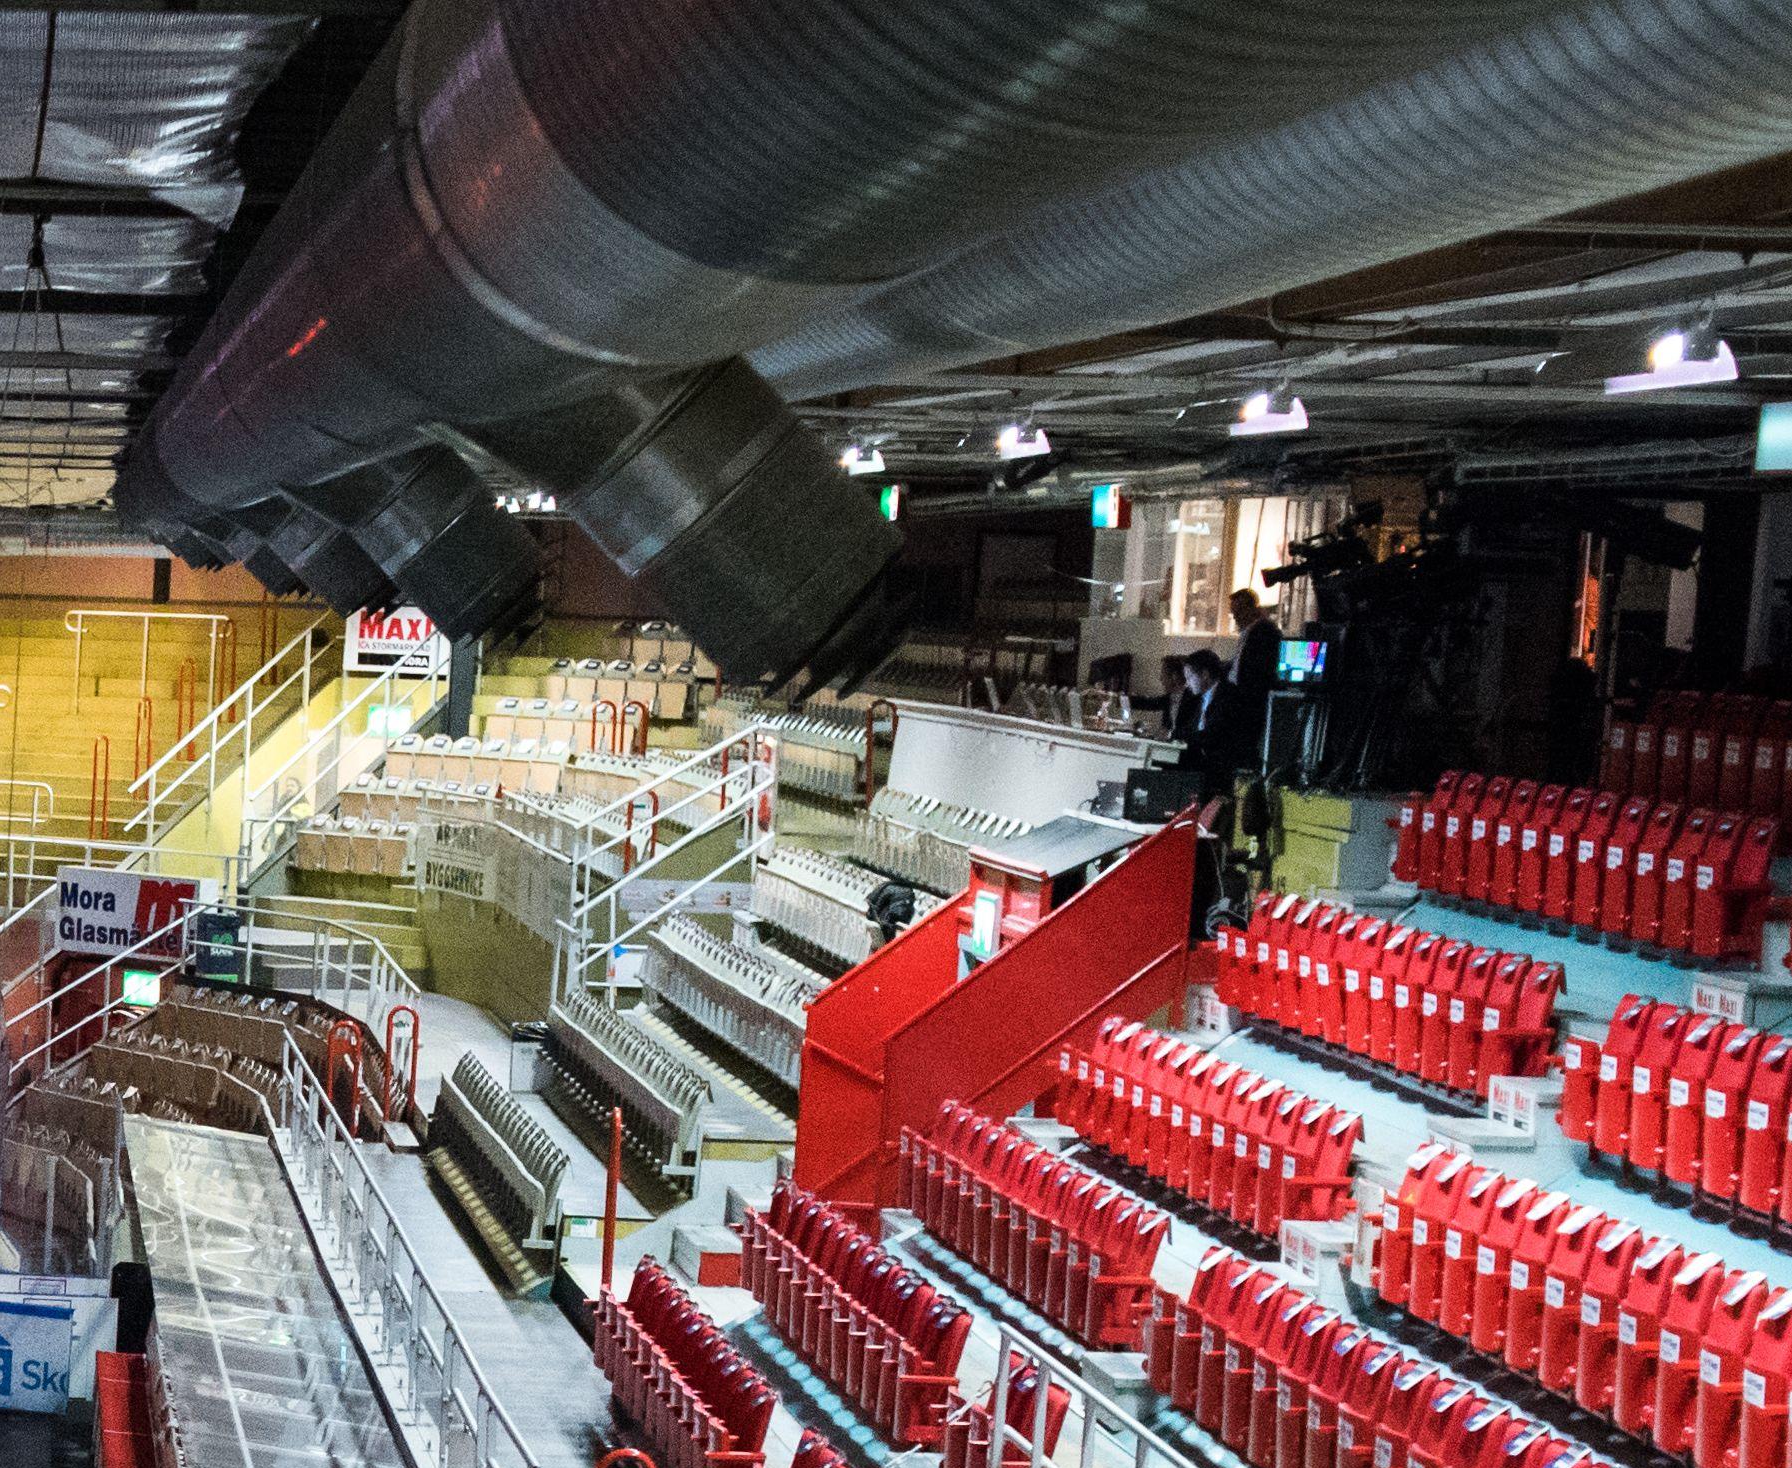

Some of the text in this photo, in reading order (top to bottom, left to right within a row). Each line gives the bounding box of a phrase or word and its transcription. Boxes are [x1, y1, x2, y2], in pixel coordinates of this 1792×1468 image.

[359, 611, 435, 641] MAXI
[372, 642, 431, 653] STORMARKAD
[59, 882, 116, 912] Mora
